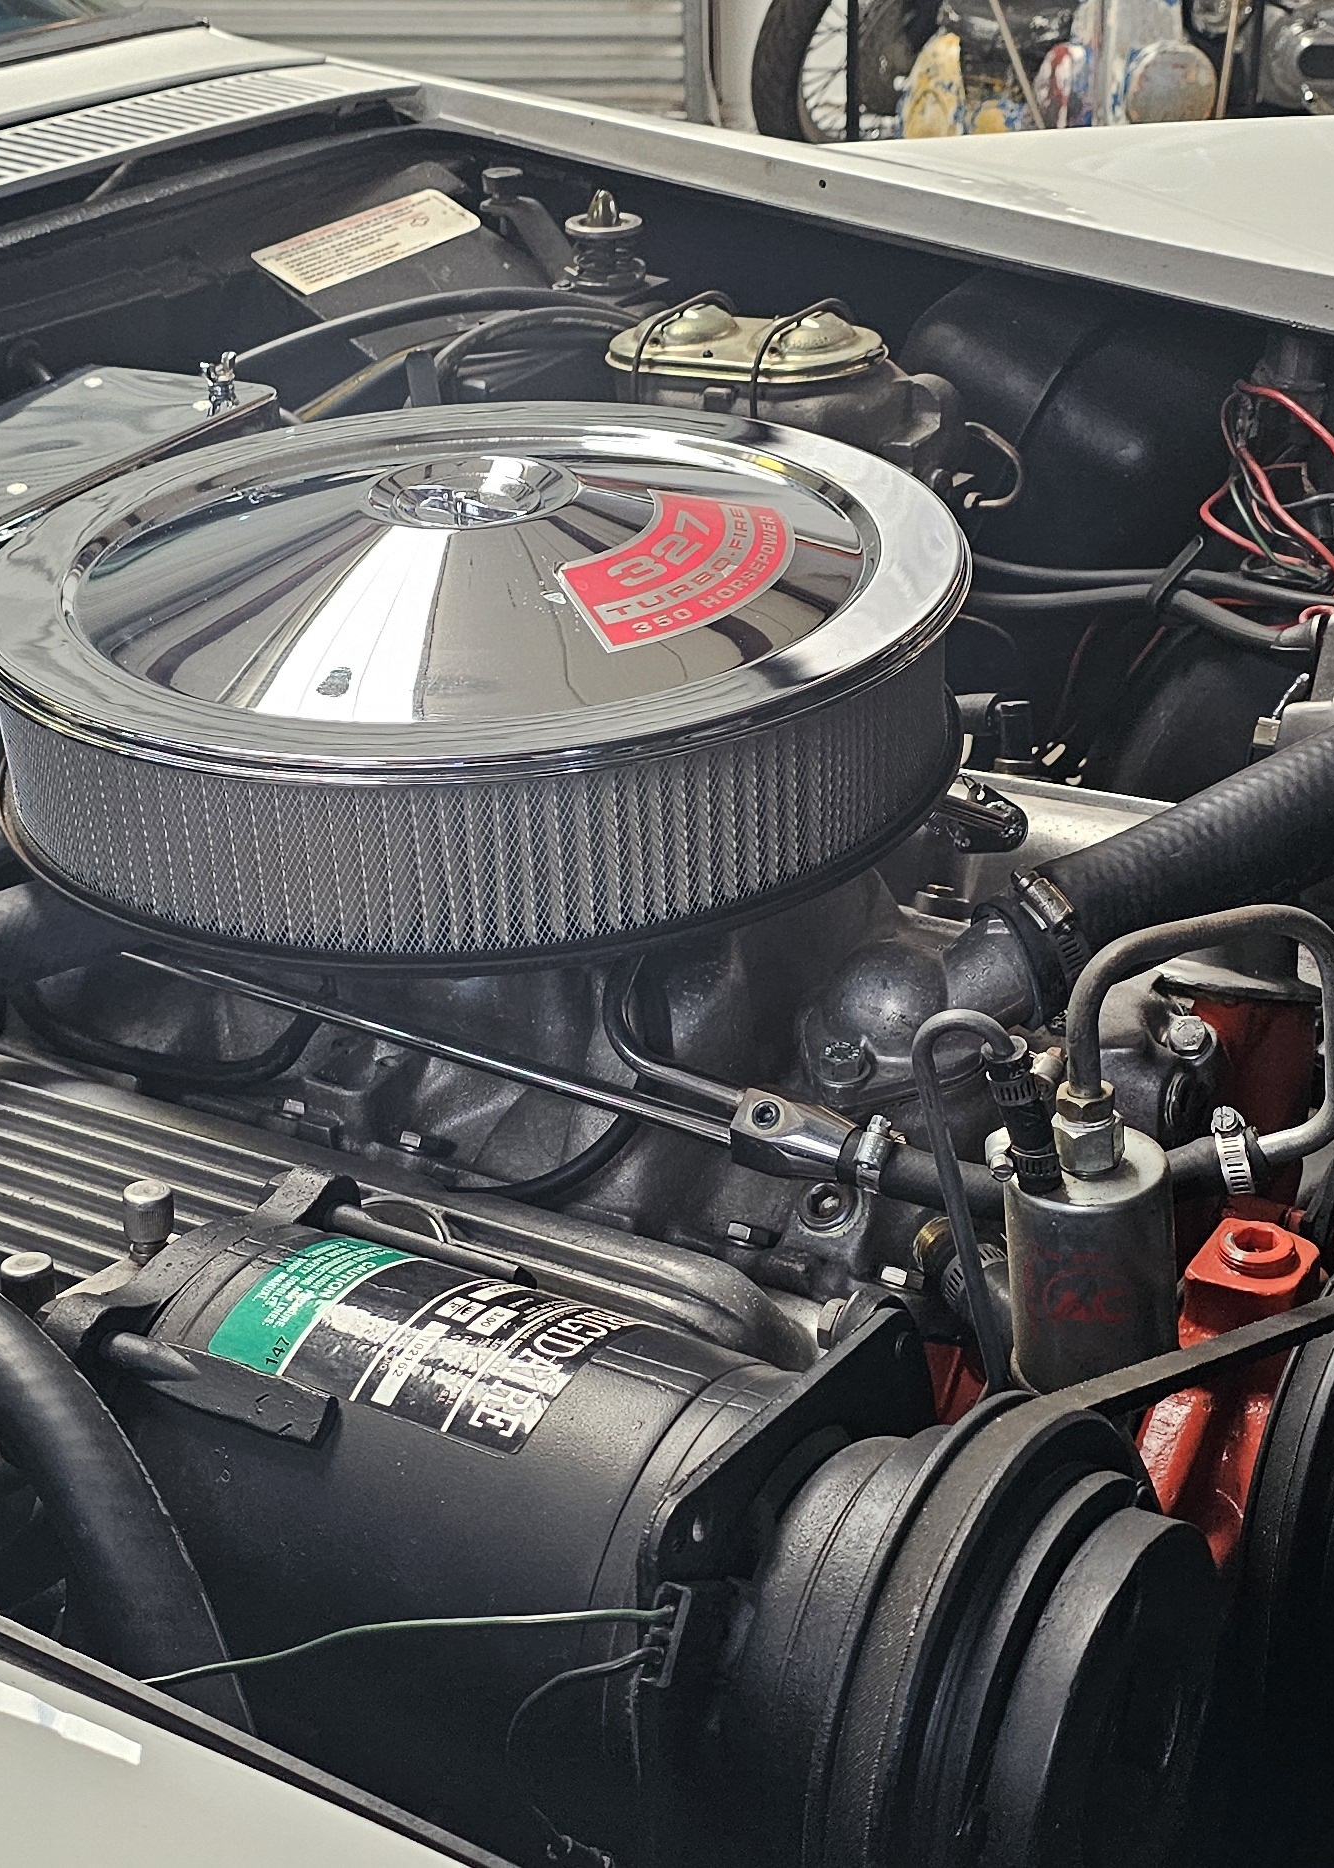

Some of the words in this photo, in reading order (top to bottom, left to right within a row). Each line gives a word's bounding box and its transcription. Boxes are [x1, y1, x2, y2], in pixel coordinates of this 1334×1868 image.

[606, 506, 749, 616] TURBO-FIRE
[607, 509, 710, 587] 327
[632, 609, 692, 633] 350
[699, 514, 777, 609] HORSEPOWER
[310, 1273, 333, 1290] HIGH
[320, 1261, 376, 1298] CAUTION
[479, 1311, 505, 1328] 3.00
[1053, 1287, 1131, 1323] AC
[266, 1336, 290, 1365] 147
[393, 1337, 429, 1377] 102162
[468, 1309, 634, 1438] RIGIDAIRE
